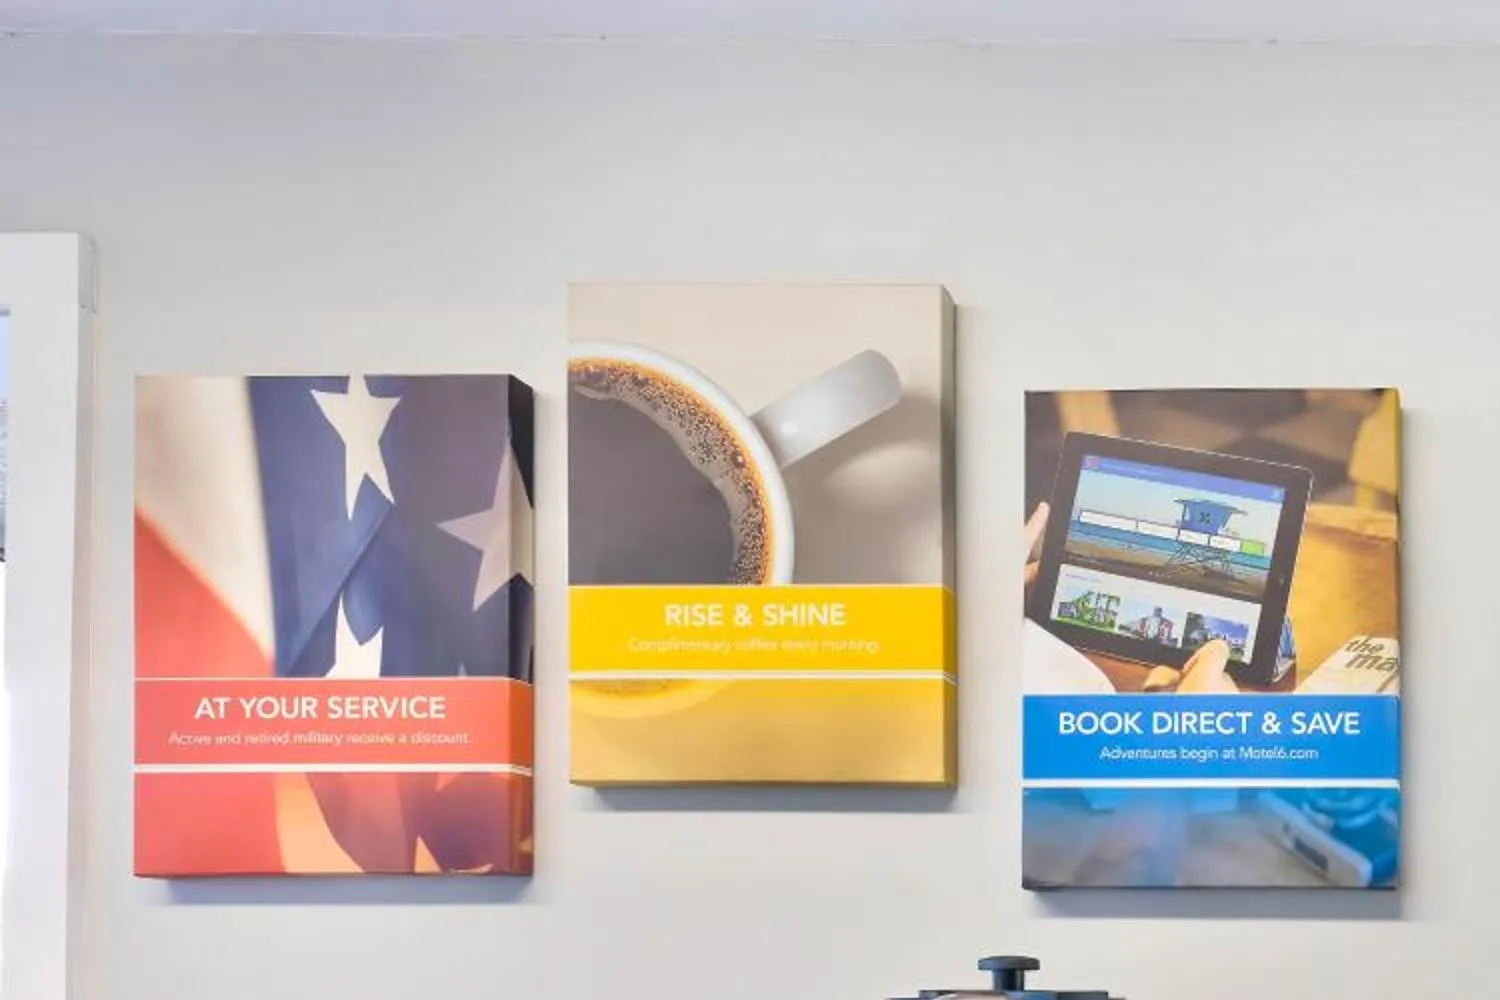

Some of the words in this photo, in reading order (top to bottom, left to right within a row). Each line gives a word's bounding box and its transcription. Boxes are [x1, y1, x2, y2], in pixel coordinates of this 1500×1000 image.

[664, 603, 724, 626] RISE
[733, 603, 753, 627] &
[762, 603, 848, 626] SHINE
[1345, 636, 1385, 653] the
[194, 697, 232, 719] AT
[239, 696, 318, 719] YOUR
[327, 696, 446, 719] SERVICE
[1059, 711, 1143, 734] BOOK
[1152, 711, 1253, 734] DIRECT
[1261, 711, 1281, 734] &
[1291, 711, 1360, 734] SAVE
[168, 731, 211, 745] Active
[215, 732, 241, 745] and
[245, 731, 290, 744] retired
[293, 731, 343, 746] military
[346, 732, 395, 744] receive
[398, 734, 407, 744] a
[1100, 746, 1177, 759] Adventures
[1180, 746, 1219, 762] begin
[1222, 748, 1236, 760] at
[1239, 746, 1319, 760] Motel6.com
